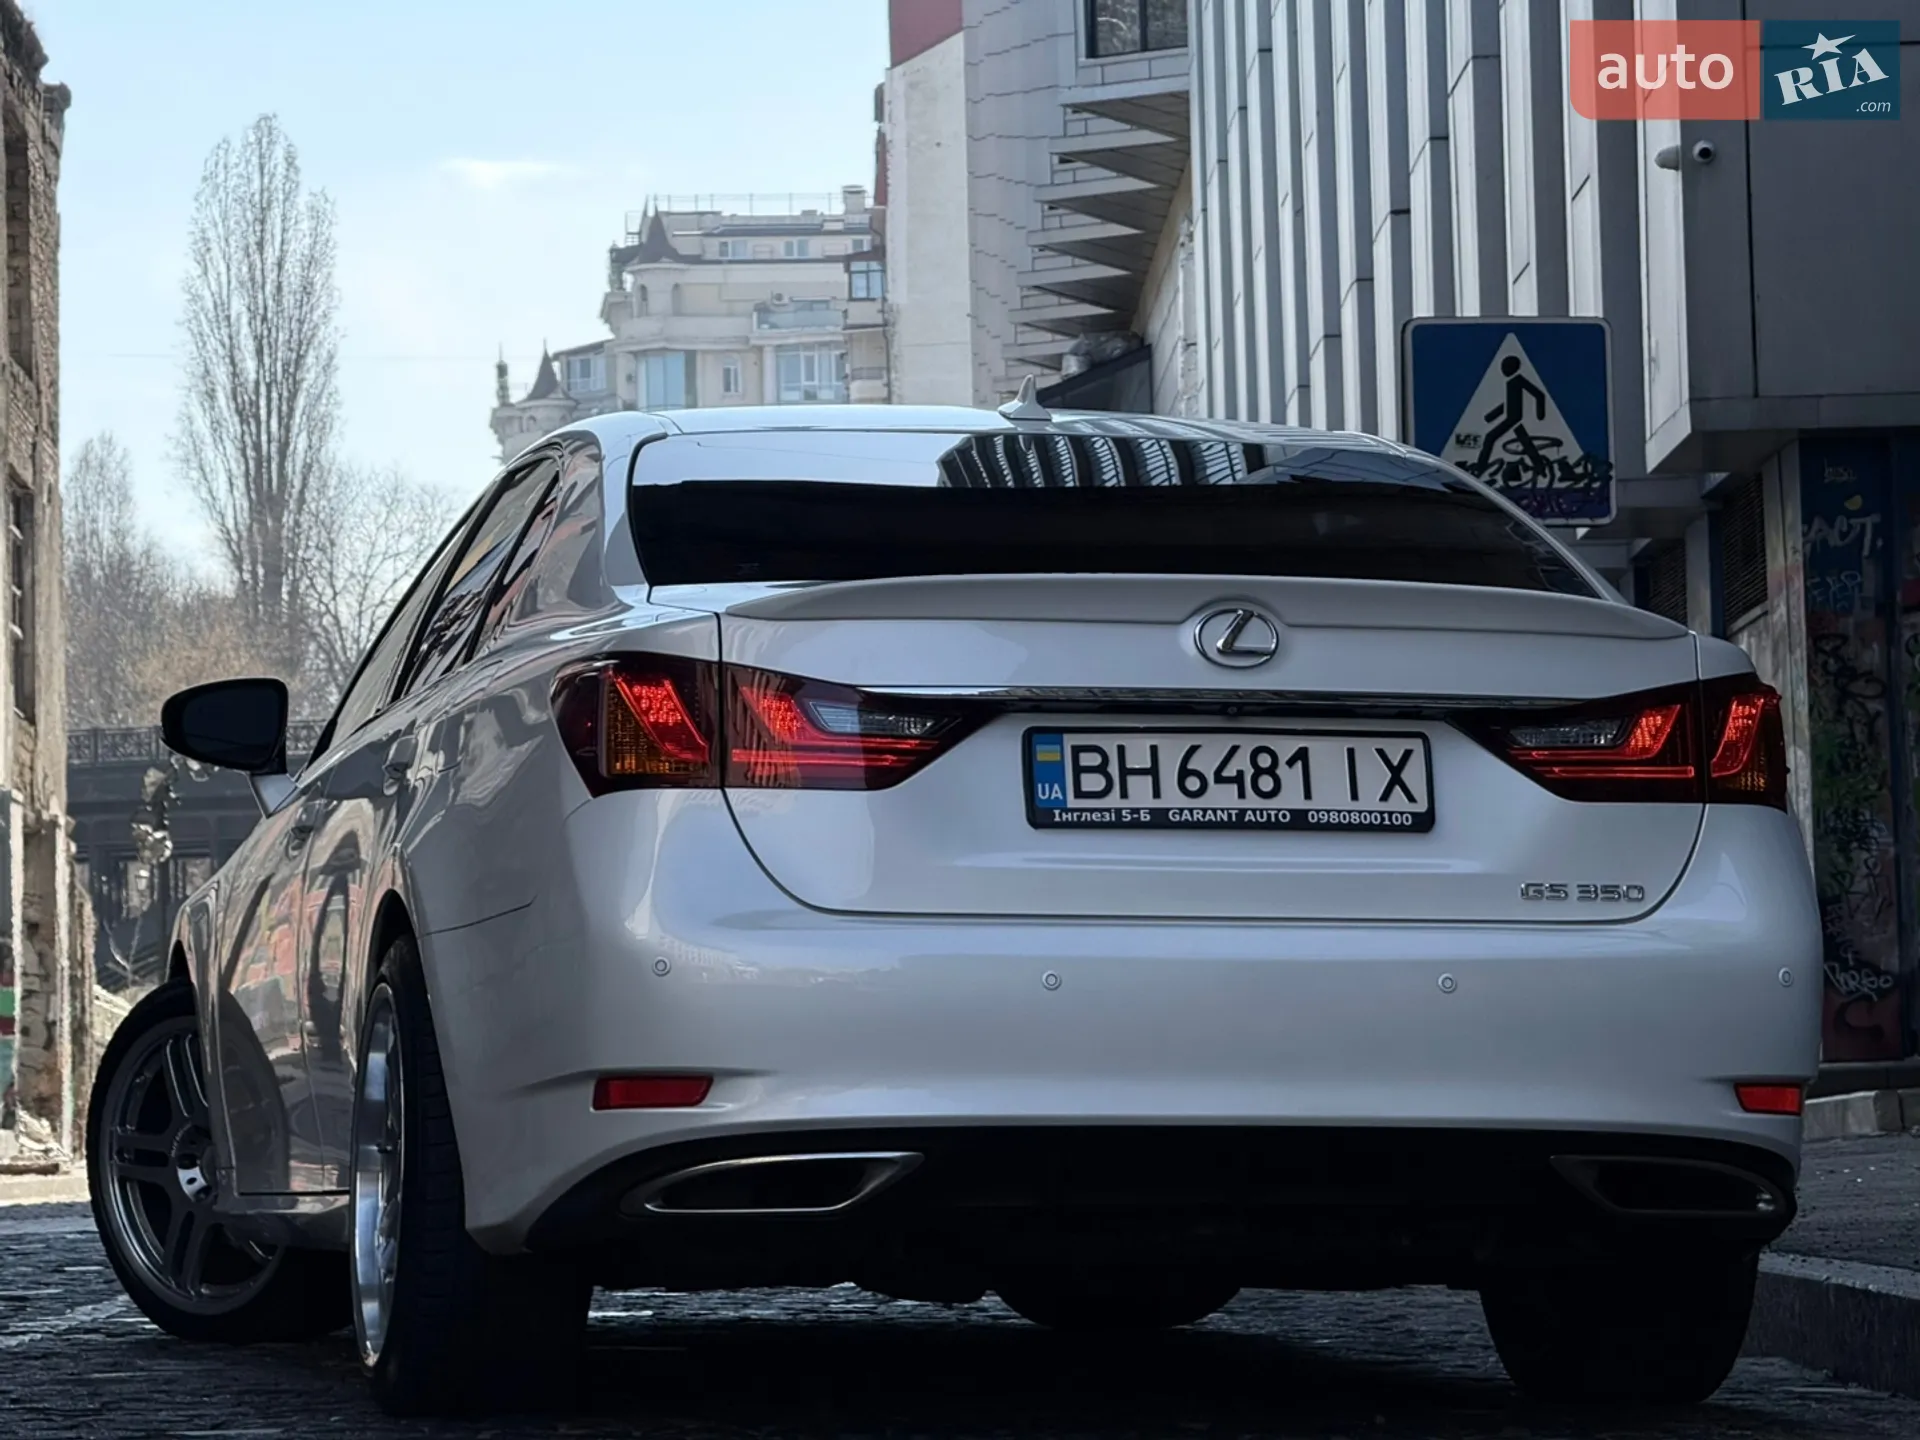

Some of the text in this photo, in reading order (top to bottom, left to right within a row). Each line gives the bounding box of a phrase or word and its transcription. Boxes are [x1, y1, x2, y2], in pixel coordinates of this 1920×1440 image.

[1070, 744, 1418, 804] BH 6481 IX
[1037, 783, 1063, 800] UA
[1053, 809, 1413, 826] Інглезі 5-Б GARANT AUTO 0980800100
[1520, 882, 1645, 902] GS 350
